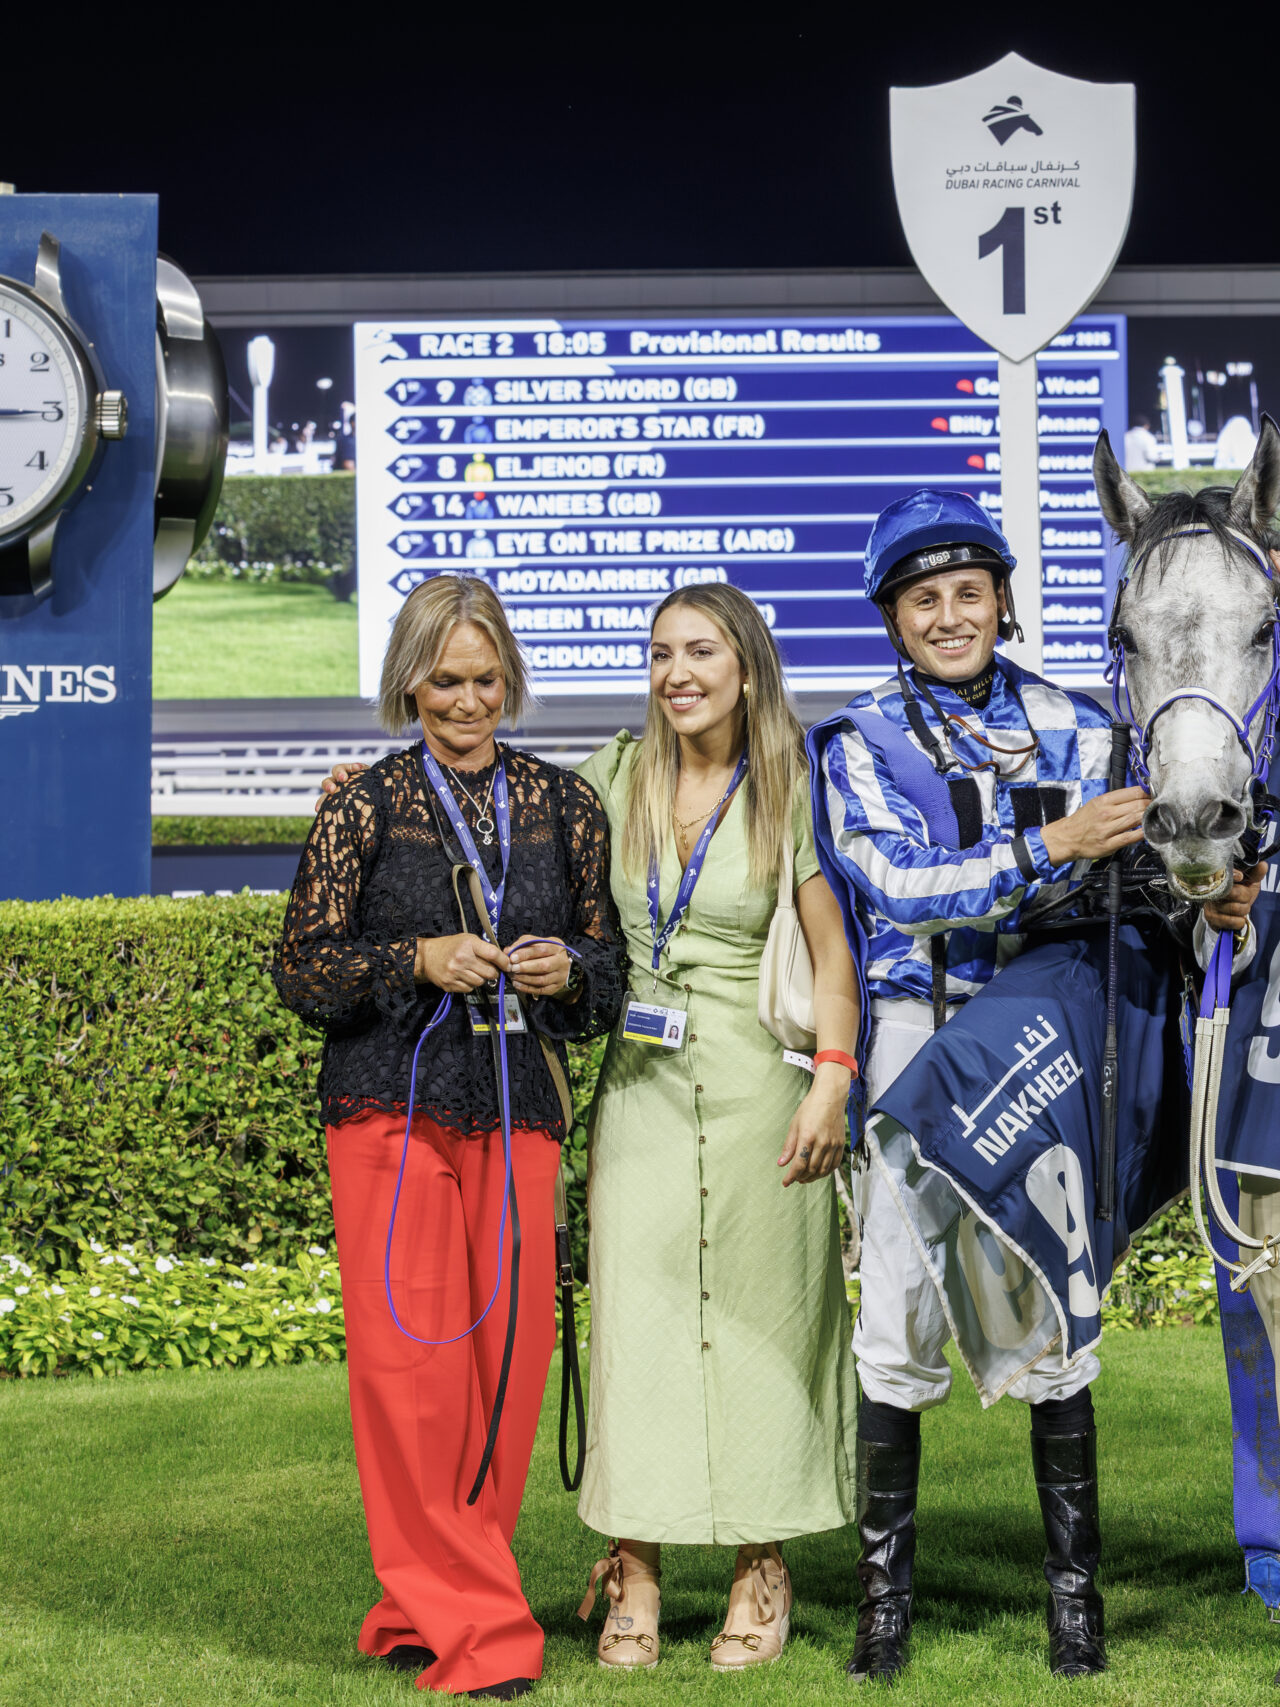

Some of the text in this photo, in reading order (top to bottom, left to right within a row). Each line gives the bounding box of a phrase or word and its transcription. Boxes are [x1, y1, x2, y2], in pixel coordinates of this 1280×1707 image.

[946, 160, 1080, 176] كرنفال سباقات دبي
[945, 176, 1081, 190] DUBAI RACING CARNIVAL
[420, 333, 492, 357] RACE
[630, 329, 778, 354] Provisional
[781, 328, 881, 352] Results
[29, 351, 50, 373] 2
[436, 380, 456, 403] 9
[494, 379, 583, 403] SILVER
[586, 378, 680, 402] SWORD
[683, 376, 738, 402] (GB)
[41, 401, 64, 423] 3
[437, 418, 456, 441] 7
[495, 416, 640, 441] EMPEROR'S
[643, 415, 710, 439] STAR
[713, 413, 766, 439] (FR)
[24, 450, 49, 471] 4
[437, 456, 457, 479] 8
[496, 455, 611, 479] ELJENOB
[613, 453, 667, 479] (FR)
[432, 494, 466, 517] 14
[496, 492, 606, 517] WANEES
[608, 490, 662, 517] (GB)
[432, 532, 463, 556] 11
[497, 531, 547, 555] EYE
[549, 530, 587, 554] ON
[589, 530, 642, 554] THE
[645, 529, 722, 553] PRIZE
[725, 527, 795, 553] (ARG)
[497, 568, 671, 592] MOTADARREK
[0, 664, 117, 704] NES
[972, 674, 993, 692] HILLS
[972, 1050, 1084, 1167] NAKHEEL
